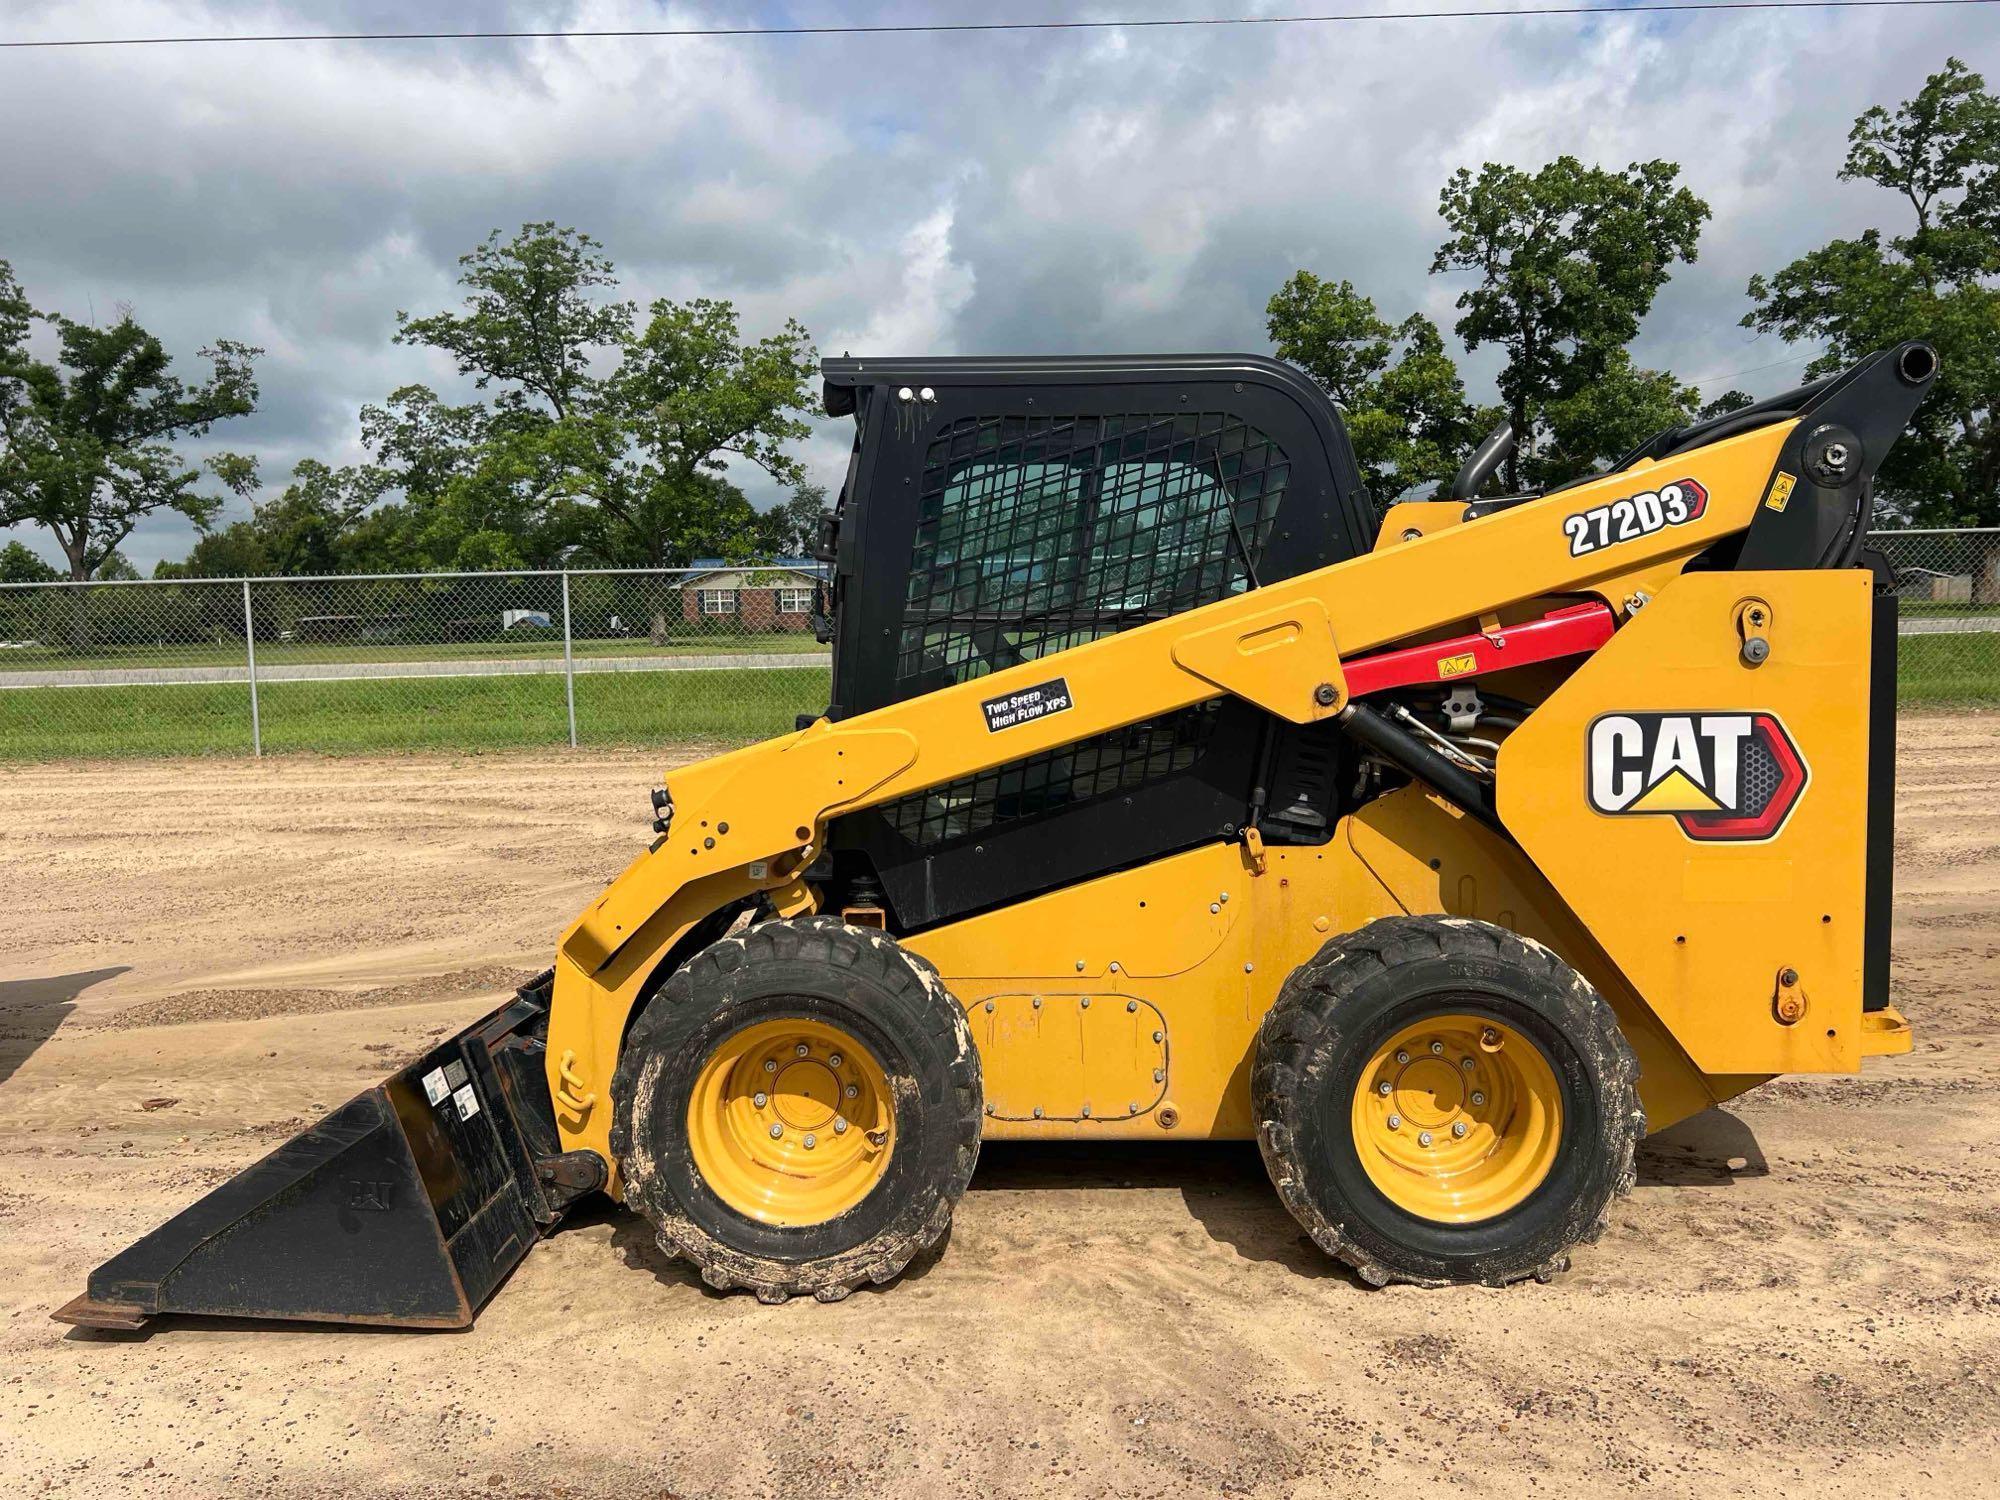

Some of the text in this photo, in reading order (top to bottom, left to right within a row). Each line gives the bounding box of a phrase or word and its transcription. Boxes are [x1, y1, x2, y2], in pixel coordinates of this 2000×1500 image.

[1565, 486, 1687, 555] 272D3
[986, 691, 1041, 716] TWO SPEED
[992, 696, 1067, 728] HIGH FLOW XPS
[1592, 716, 1751, 811] CAT
